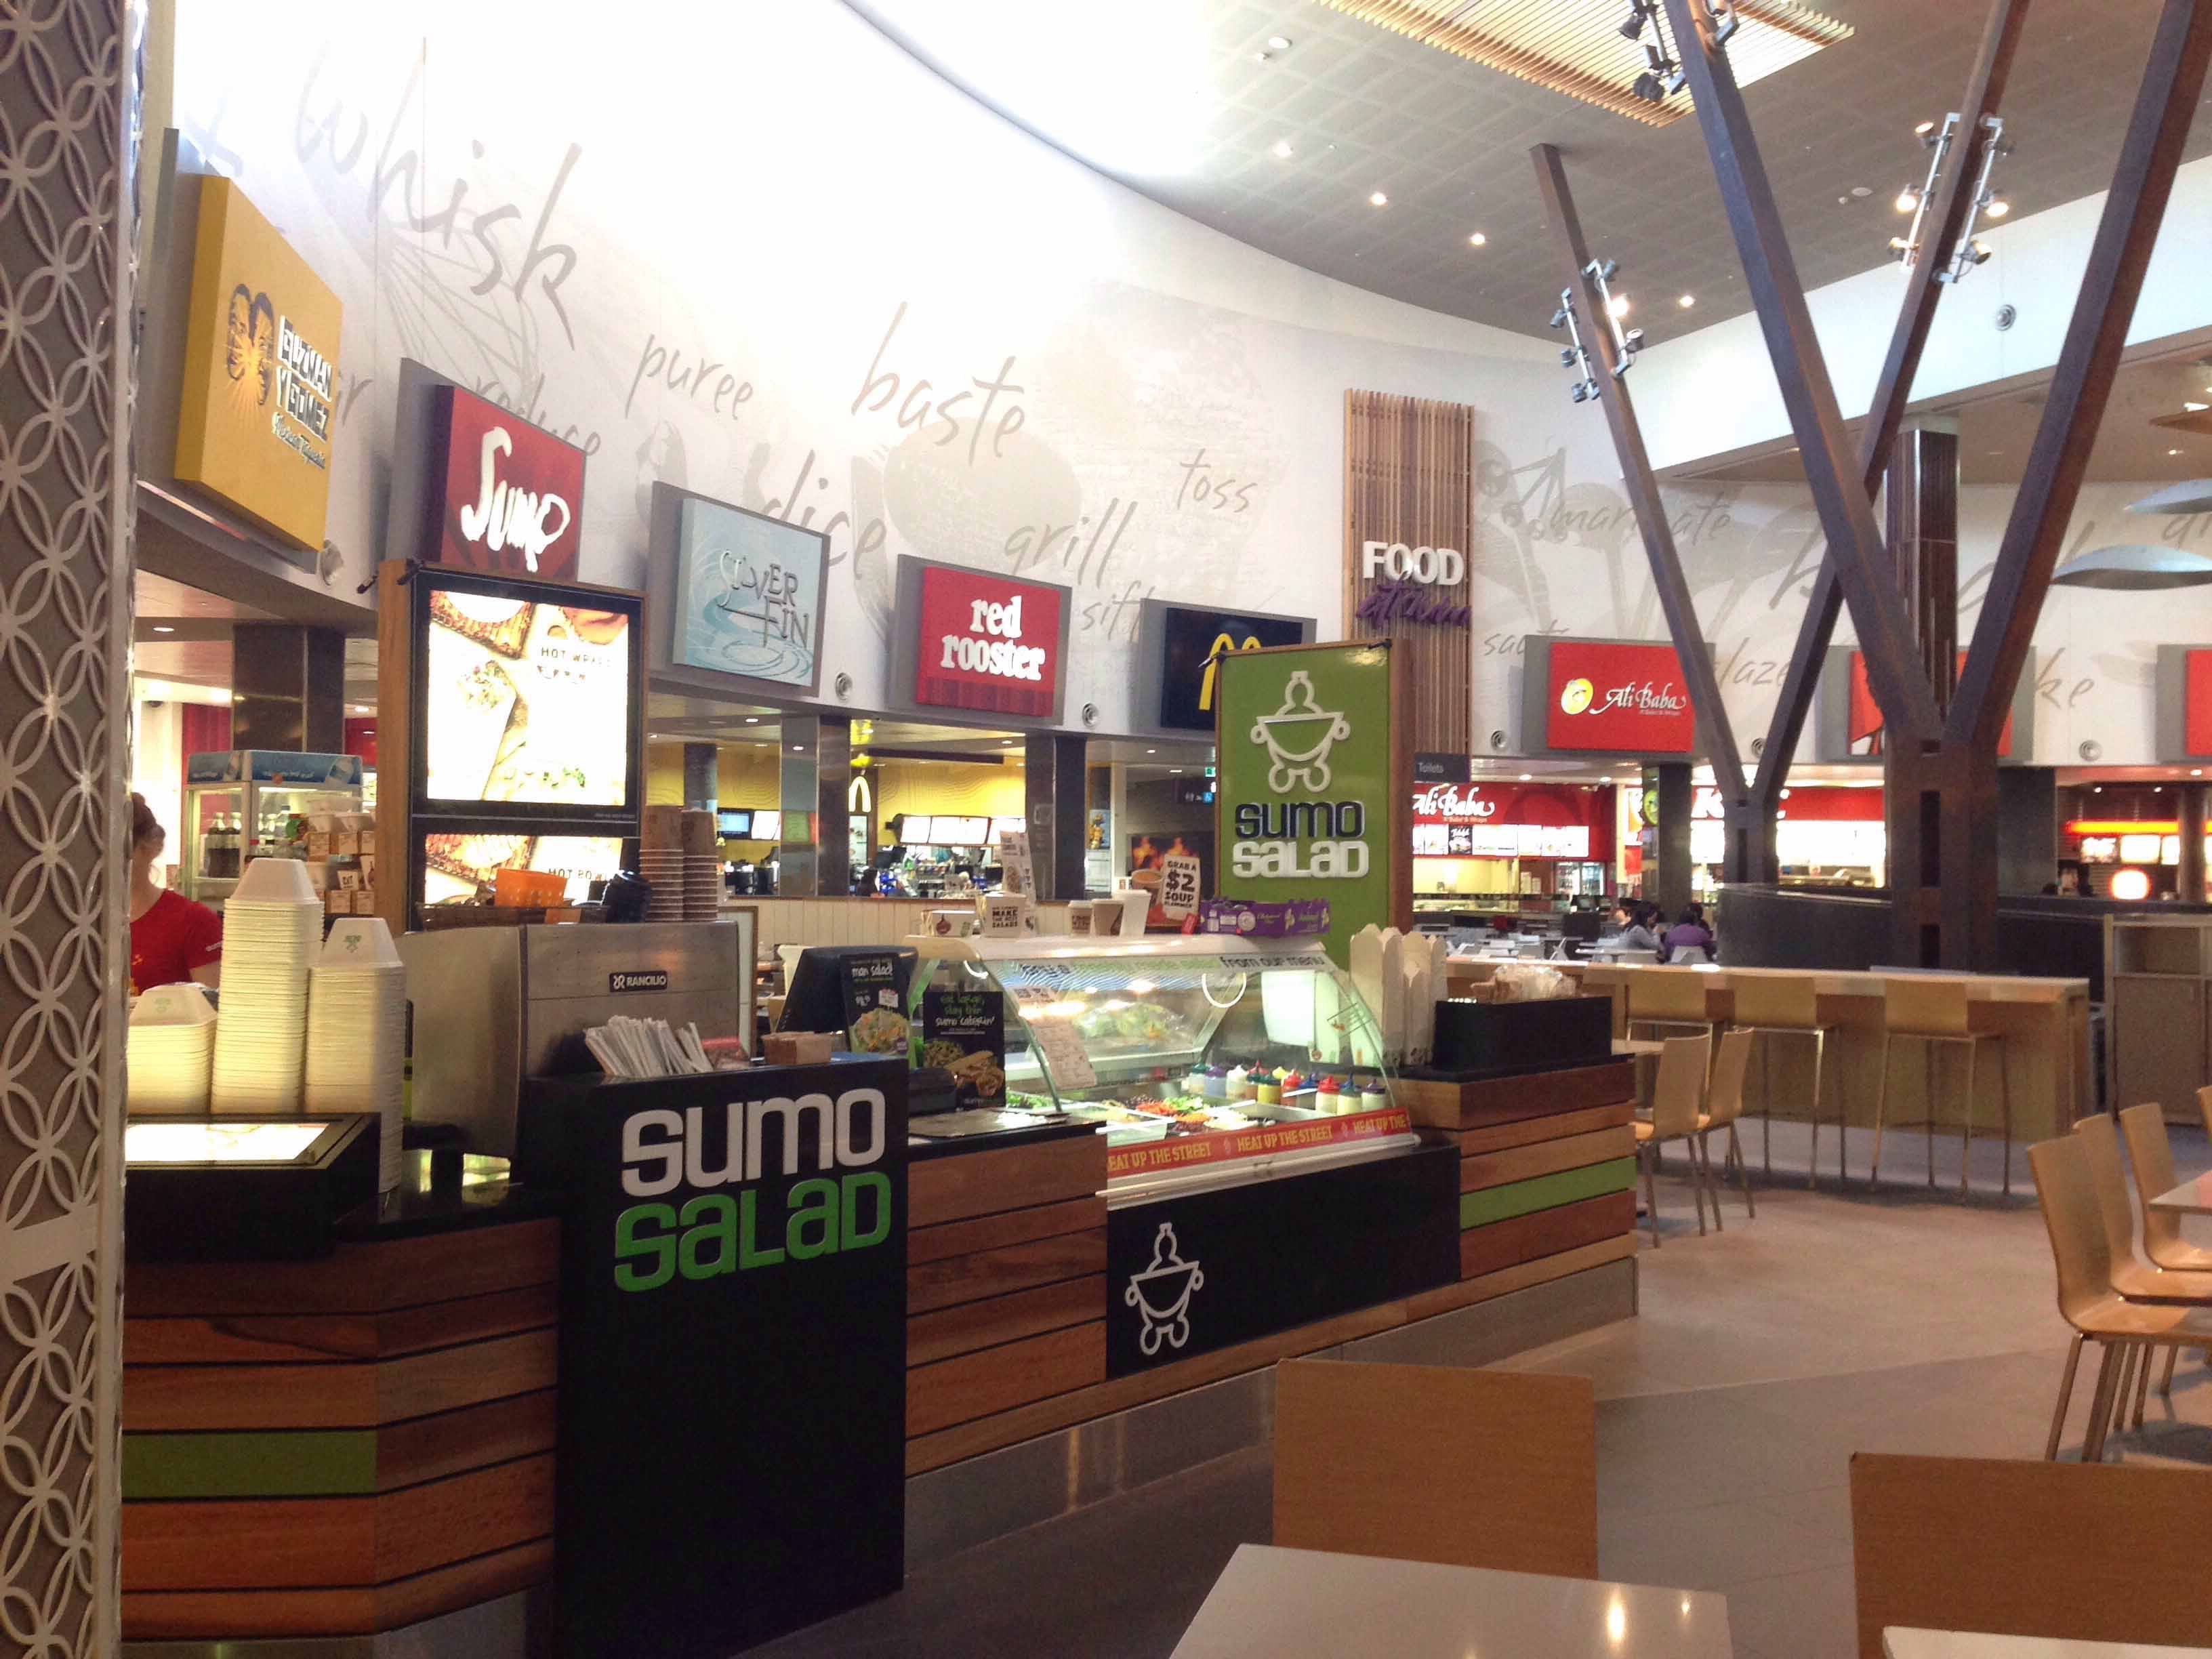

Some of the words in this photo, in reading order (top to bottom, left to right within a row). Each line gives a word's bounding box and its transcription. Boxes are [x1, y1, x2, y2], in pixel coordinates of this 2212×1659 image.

[294, 37, 583, 351] whisk
[625, 333, 754, 420] puree
[851, 301, 1026, 466] baste
[1176, 449, 1258, 514] toss
[1004, 497, 1139, 589] grill
[1363, 540, 1465, 586] FOOD
[748, 597, 811, 651] FIN
[969, 594, 1023, 639] red
[541, 647, 566, 659] HOT
[940, 634, 1047, 682] rooster
[1589, 682, 1636, 715] Ali
[1635, 681, 1686, 710] Baba
[1235, 800, 1365, 839] sumo
[1437, 786, 1495, 817] Baba
[1165, 869, 1195, 892] $2
[1167, 860, 1189, 869] GRAB
[1164, 891, 1194, 902] SOUP
[1220, 956, 1259, 968] from
[1286, 956, 1325, 966] menu
[626, 975, 667, 989] RANCILIO
[621, 1088, 886, 1197] sumo
[1237, 1136, 1263, 1152] HEAT
[1265, 1134, 1278, 1149] UP
[1279, 1132, 1299, 1147] THE
[1299, 1125, 1334, 1145] STREET
[1354, 1120, 1376, 1134] HEAT
[1376, 1118, 1389, 1131] UP
[1389, 1115, 1407, 1130] THE
[1132, 1151, 1147, 1168] UP
[1150, 1148, 1172, 1164] THE
[1172, 1142, 1212, 1162] STREET
